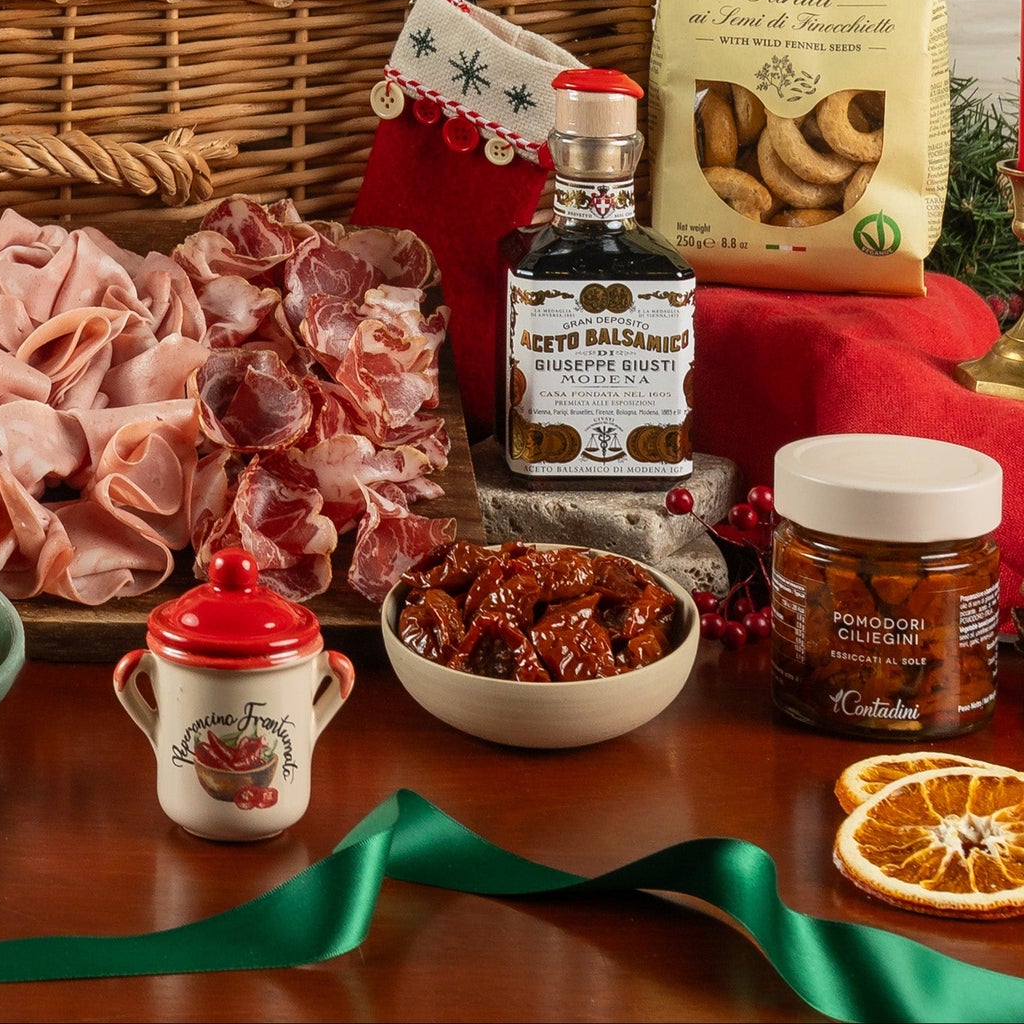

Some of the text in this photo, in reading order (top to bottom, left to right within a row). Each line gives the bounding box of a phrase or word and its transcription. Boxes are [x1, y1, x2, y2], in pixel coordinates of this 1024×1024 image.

[689, 6, 896, 34] ai Semi di Finocchietto
[719, 36, 862, 53] WITH WILD FENNEL SEEDS
[676, 222, 711, 234] Net weight
[677, 235, 695, 247] 250
[721, 237, 737, 249] 8.8
[739, 241, 749, 249] oz
[563, 316, 650, 331] GRAN DEPOSITO
[521, 328, 689, 353] ACETO BALSAMICO
[535, 359, 676, 372] GIUSEPPE GIUSTI
[561, 375, 650, 384] MODENA
[524, 465, 553, 473] ACETO
[557, 465, 610, 473] BALSAMICO
[613, 465, 623, 473] DI
[627, 465, 667, 473] MODENA
[833, 612, 925, 630] POMODORI
[838, 628, 919, 645] CILIEGINI
[831, 650, 881, 664] ESSICCATI
[902, 657, 927, 666] SOLE
[842, 690, 920, 719] Contadini
[172, 702, 298, 784] Peperoncino Frantumato
